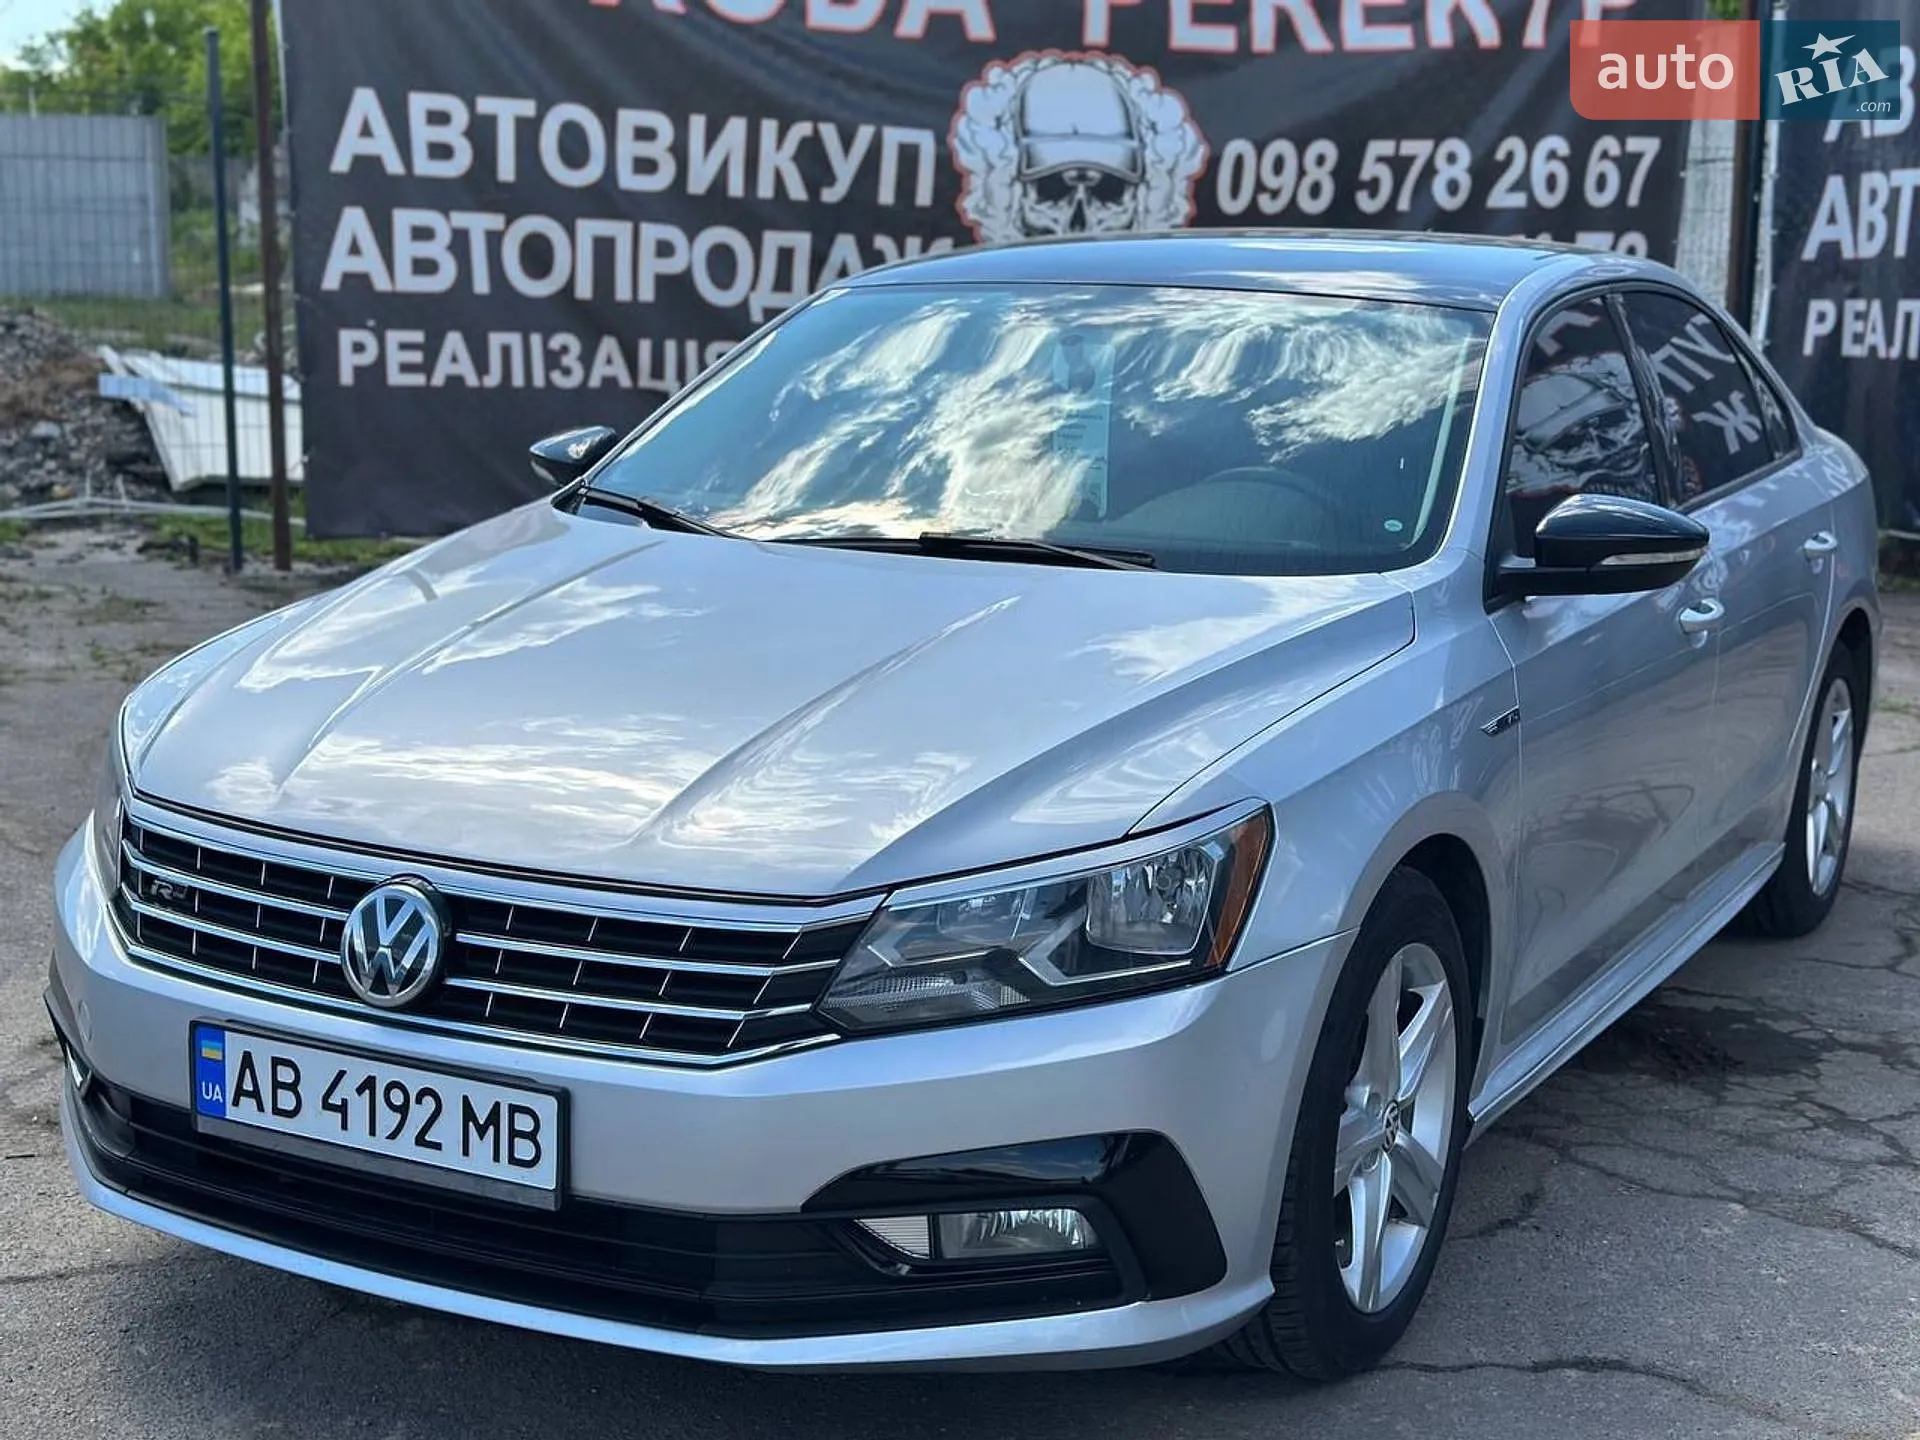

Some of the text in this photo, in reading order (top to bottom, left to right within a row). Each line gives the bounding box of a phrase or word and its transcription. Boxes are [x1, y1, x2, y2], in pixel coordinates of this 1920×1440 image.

[330, 87, 936, 207] АВТОВИКУП
[1216, 135, 1661, 214] 098 578 26 67
[201, 1080, 224, 1103] UA
[231, 1050, 542, 1169] AB 4192 MB
